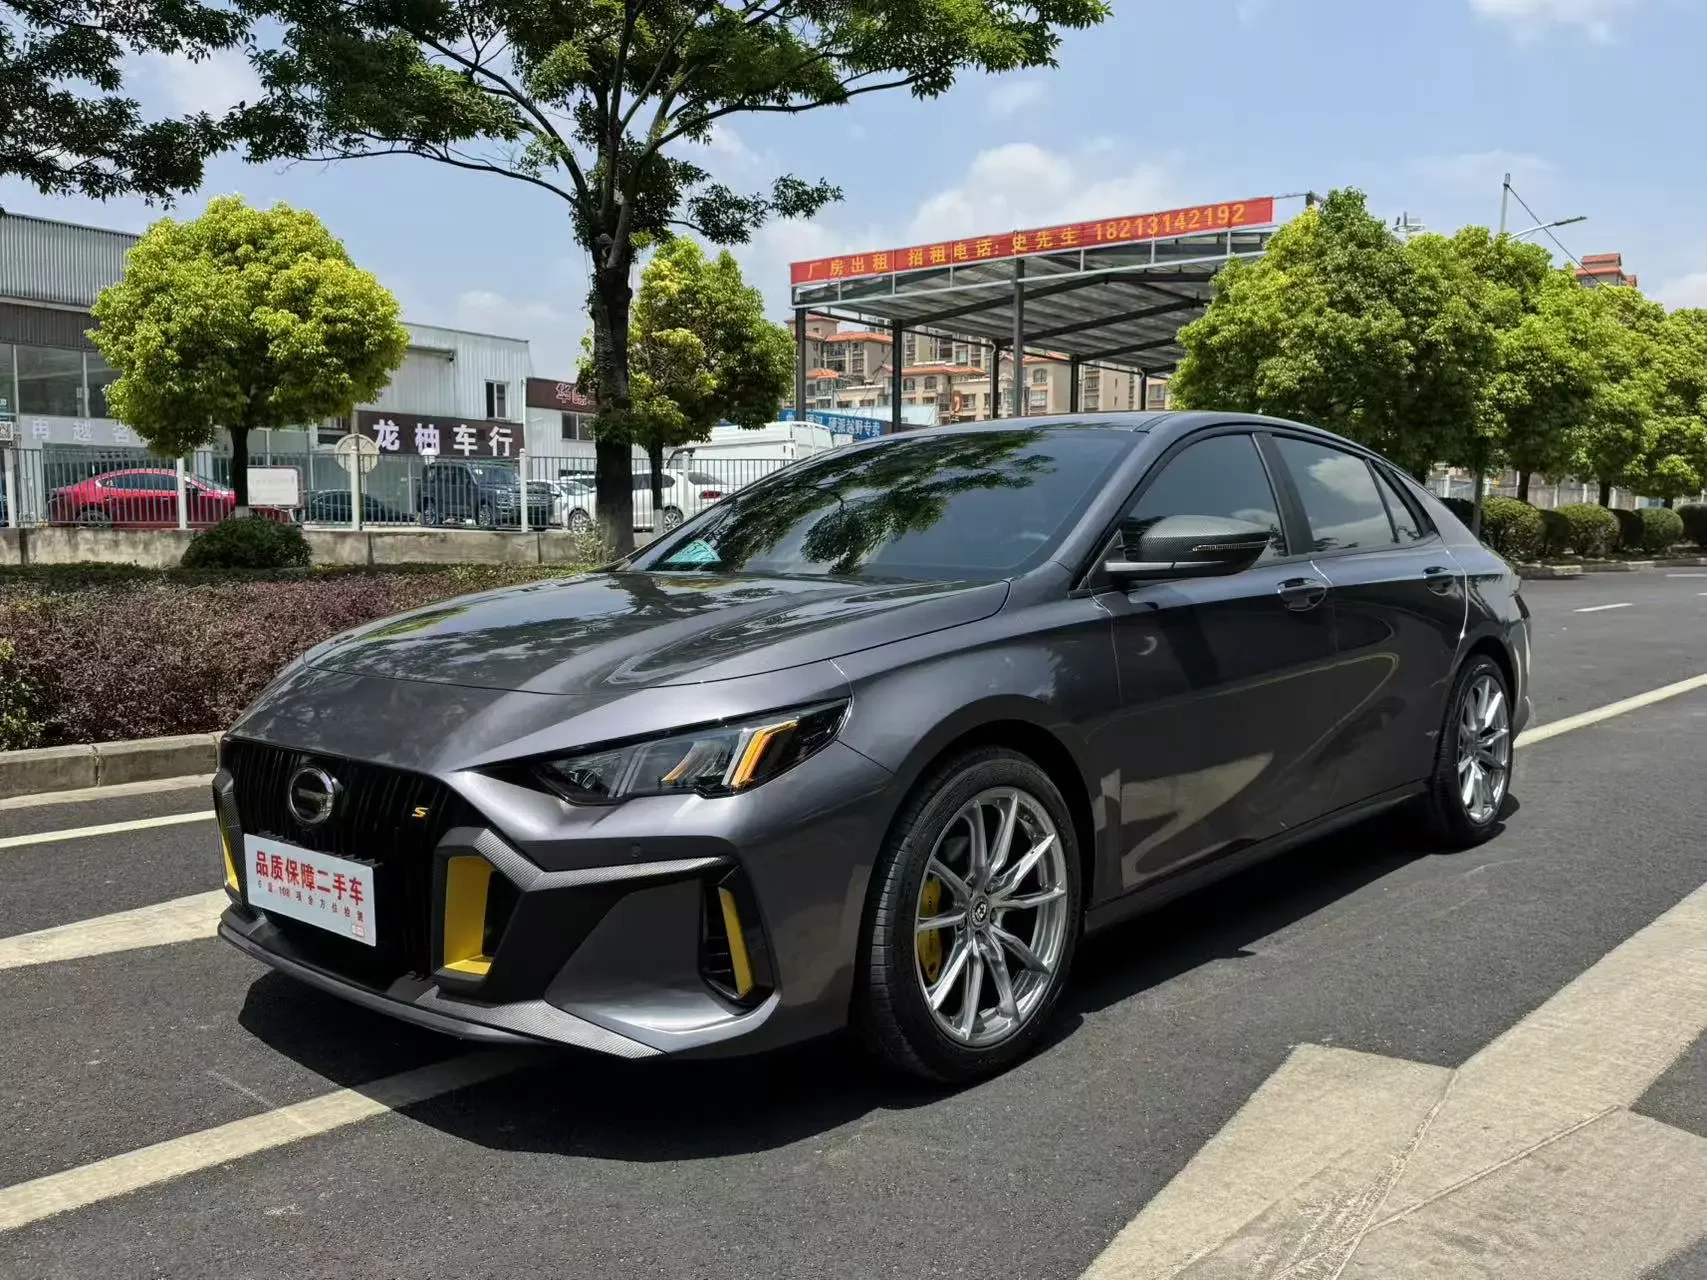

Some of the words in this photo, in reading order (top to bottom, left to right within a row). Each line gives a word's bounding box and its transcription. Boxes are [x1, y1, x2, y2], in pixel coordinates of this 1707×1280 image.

[807, 254, 888, 278] 厂房出租
[1095, 203, 1246, 241] 18213142192
[411, 806, 429, 818] S
[255, 850, 364, 906] 品质保障二手车
